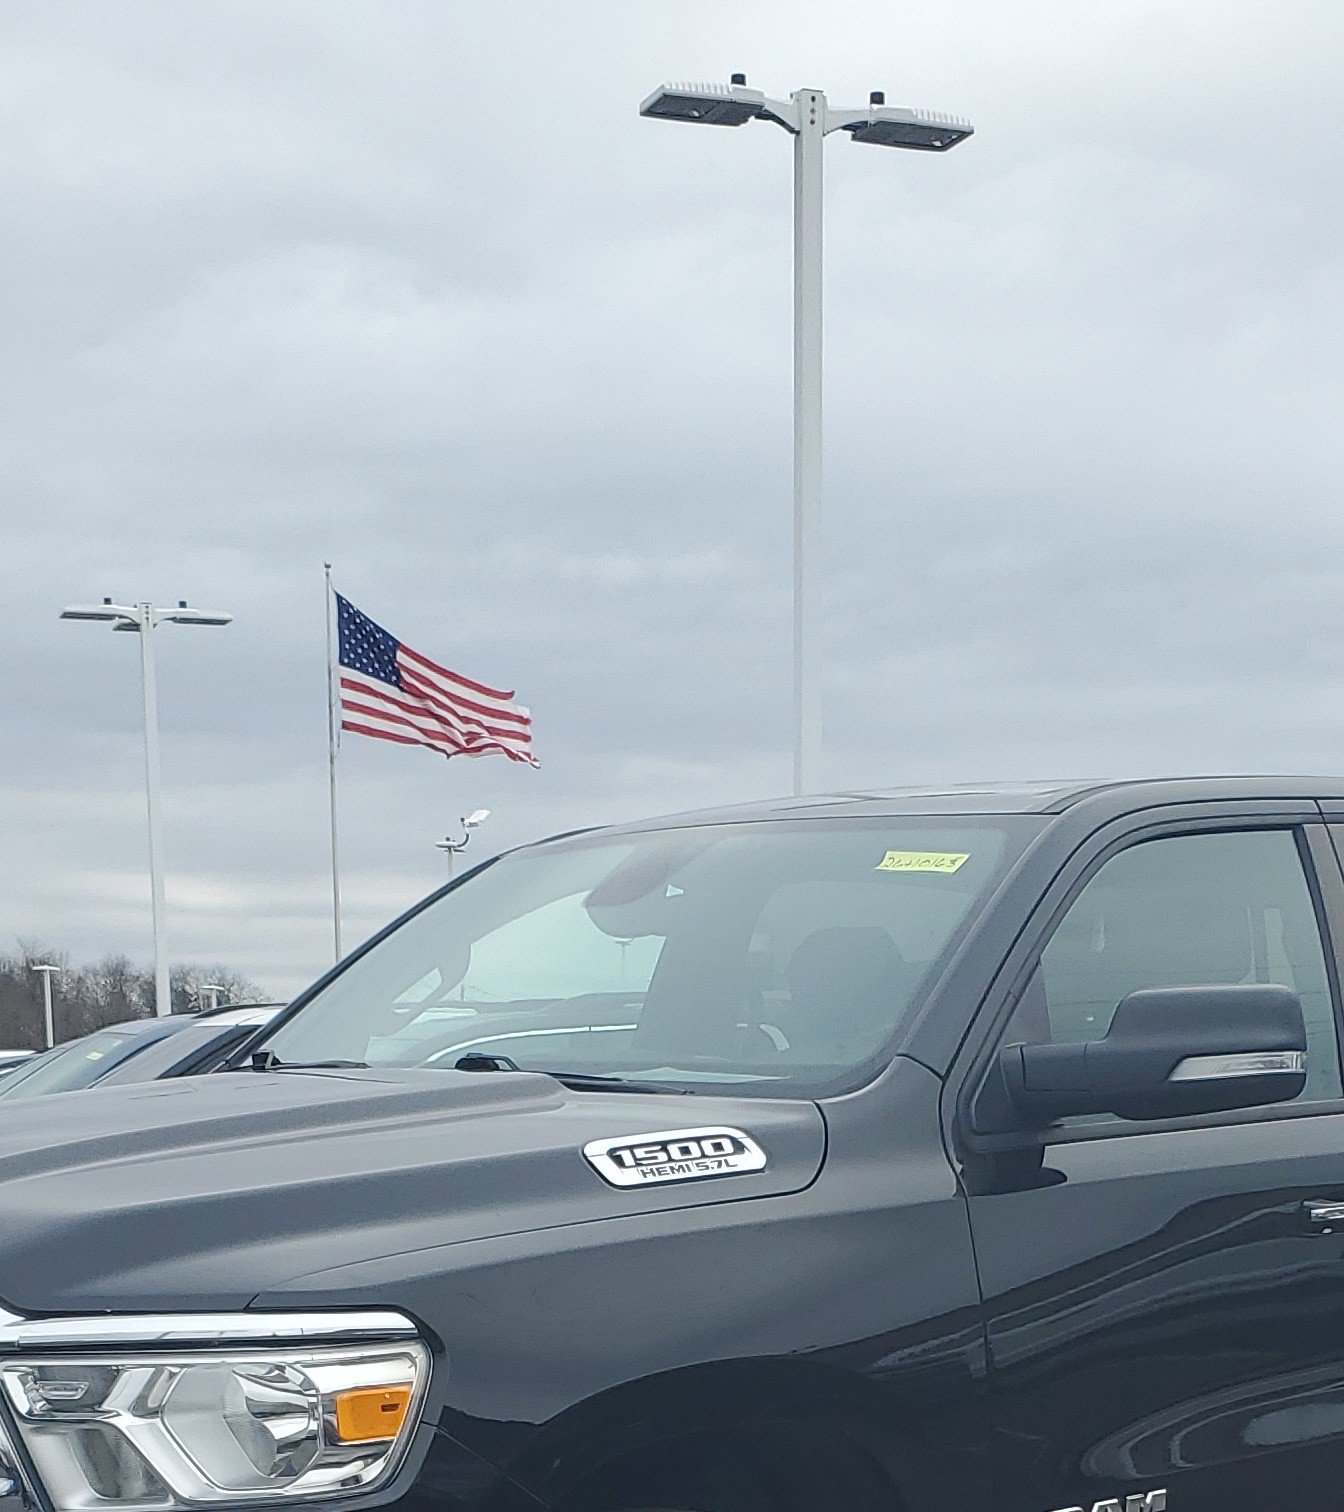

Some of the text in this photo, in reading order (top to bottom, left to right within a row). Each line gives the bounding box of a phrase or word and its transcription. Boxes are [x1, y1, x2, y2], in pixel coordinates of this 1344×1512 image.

[613, 1137, 738, 1168] 1500
[639, 1157, 738, 1179] HEMI 5.7L
